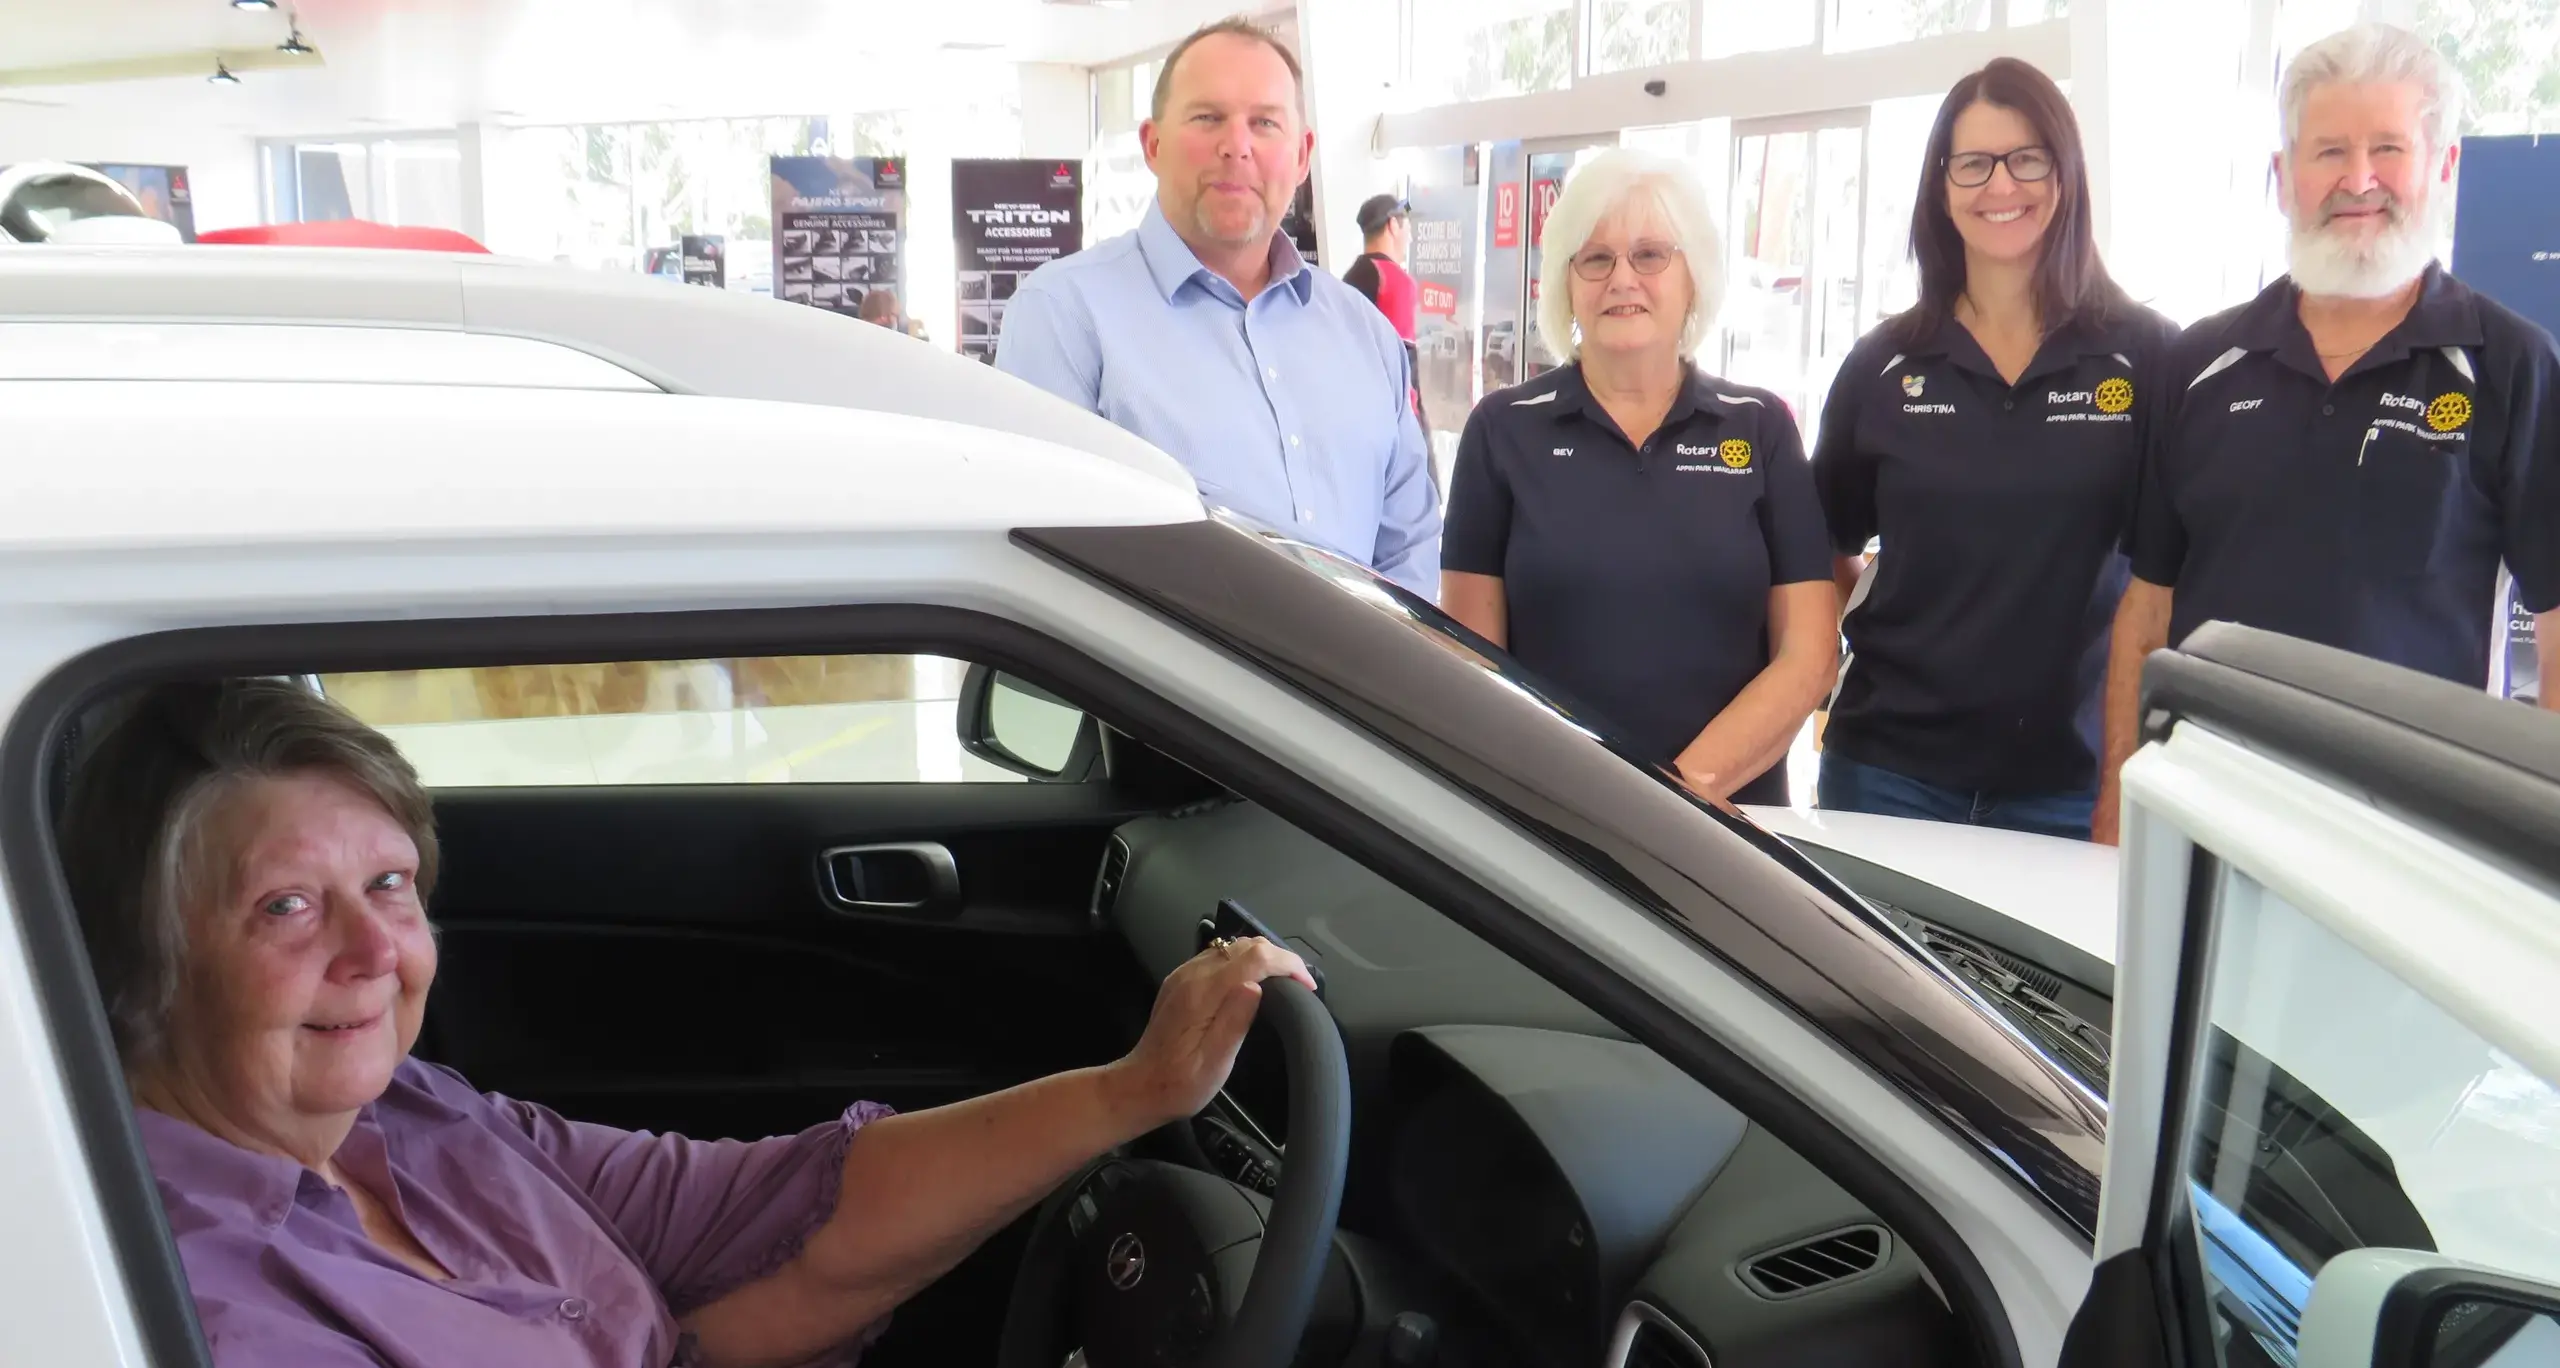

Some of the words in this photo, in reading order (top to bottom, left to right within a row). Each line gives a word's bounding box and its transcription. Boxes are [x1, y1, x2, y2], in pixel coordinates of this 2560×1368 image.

[1498, 188, 1513, 218] 10
[793, 219, 830, 229] GENUINE
[832, 219, 886, 229] ACCESSORIES
[966, 210, 1070, 224] TRITON
[985, 227, 1053, 238] ACCESSORIES
[1417, 221, 1445, 241] SCORE
[1416, 243, 1449, 260] SAVINGS
[1424, 288, 1438, 308] GET
[2048, 391, 2093, 405] Rotary
[2380, 392, 2427, 417] Rotary
[1903, 403, 1956, 414] CHRISTINA
[2229, 398, 2263, 413] GEOFF
[2046, 413, 2068, 423] APPIN
[2068, 412, 2087, 422] PARK
[2372, 418, 2395, 429] APPIN
[2394, 421, 2417, 434] PARK
[2416, 427, 2465, 442] WANGARATTA
[1553, 448, 1574, 457] BEV
[1676, 444, 1718, 457] Rotary
[1676, 464, 1695, 472] APPIN
[1695, 465, 1713, 473] PARK
[1713, 465, 1753, 475] WANGARATTA
